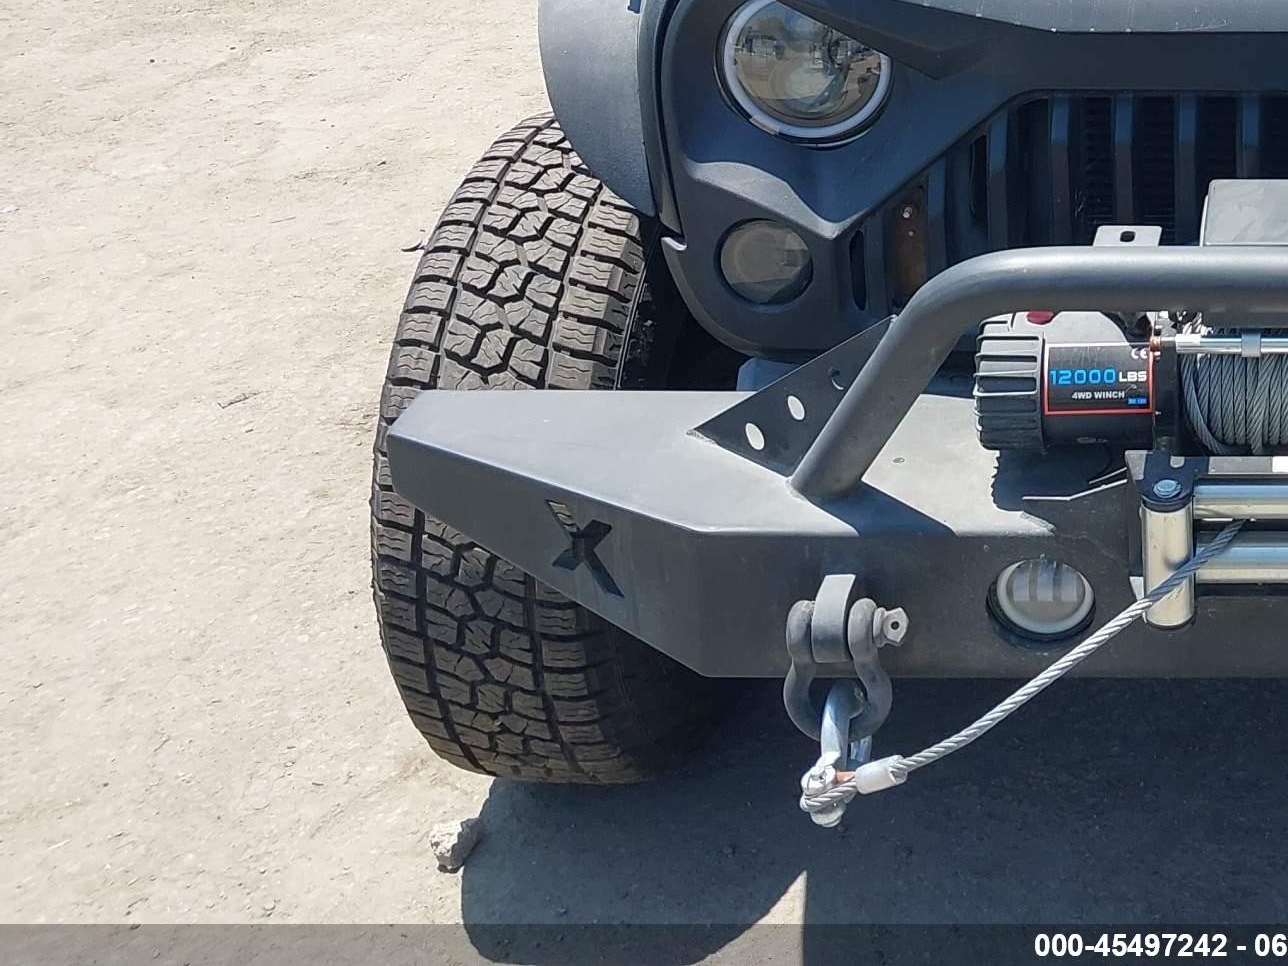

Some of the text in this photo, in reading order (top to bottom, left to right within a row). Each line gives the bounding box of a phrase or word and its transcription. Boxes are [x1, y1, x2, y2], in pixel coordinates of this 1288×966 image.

[1050, 368, 1148, 385] 12000 LBS
[1072, 390, 1125, 399] 4WD WINCH
